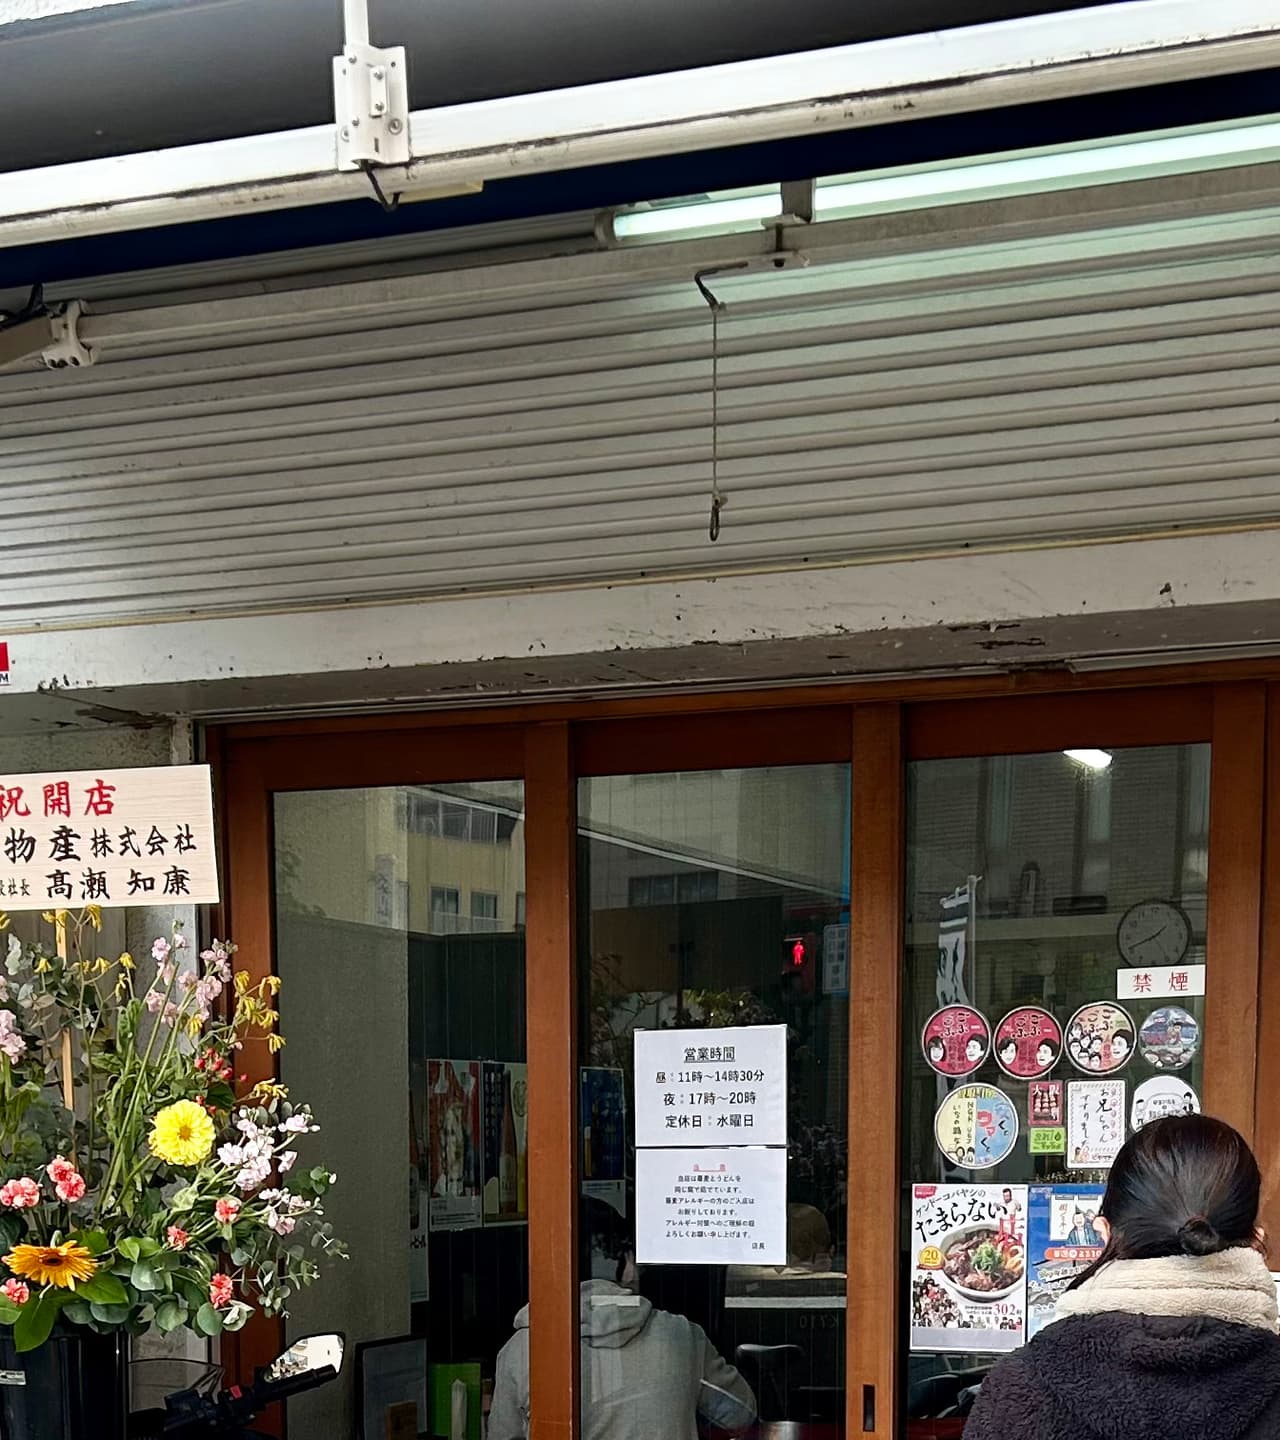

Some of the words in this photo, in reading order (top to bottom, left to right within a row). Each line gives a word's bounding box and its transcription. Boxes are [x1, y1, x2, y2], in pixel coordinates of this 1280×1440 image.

[127, 865, 192, 897] 知康
[1132, 970, 1189, 993] 禁煙
[683, 1046, 736, 1062] 営業時間
[915, 1187, 987, 1218] ケンドーコバヤシの
[915, 1198, 1008, 1243] たまらない
